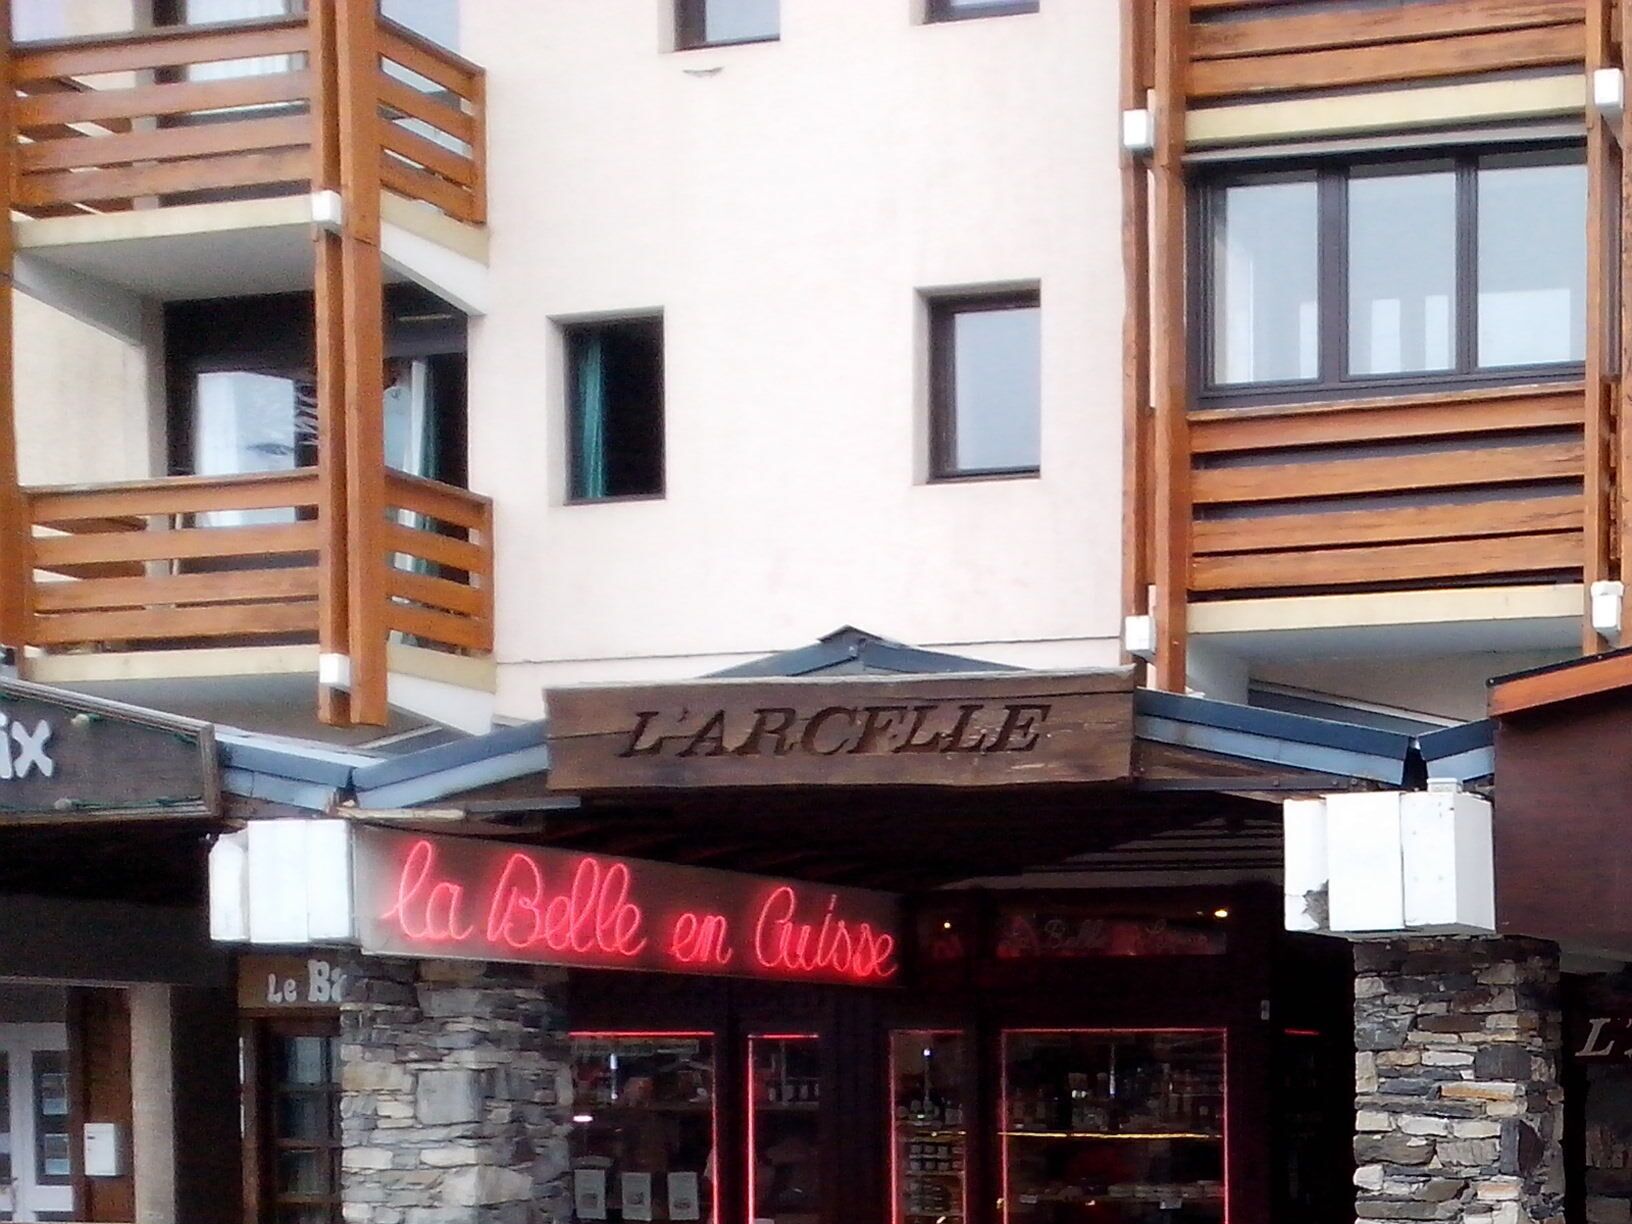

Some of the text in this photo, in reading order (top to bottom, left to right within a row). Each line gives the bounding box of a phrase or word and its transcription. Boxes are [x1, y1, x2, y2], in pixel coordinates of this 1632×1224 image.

[614, 702, 1052, 758] L'ARCELLE
[487, 852, 646, 956] Belle
[670, 911, 733, 964] en
[754, 885, 898, 978] Cuisse
